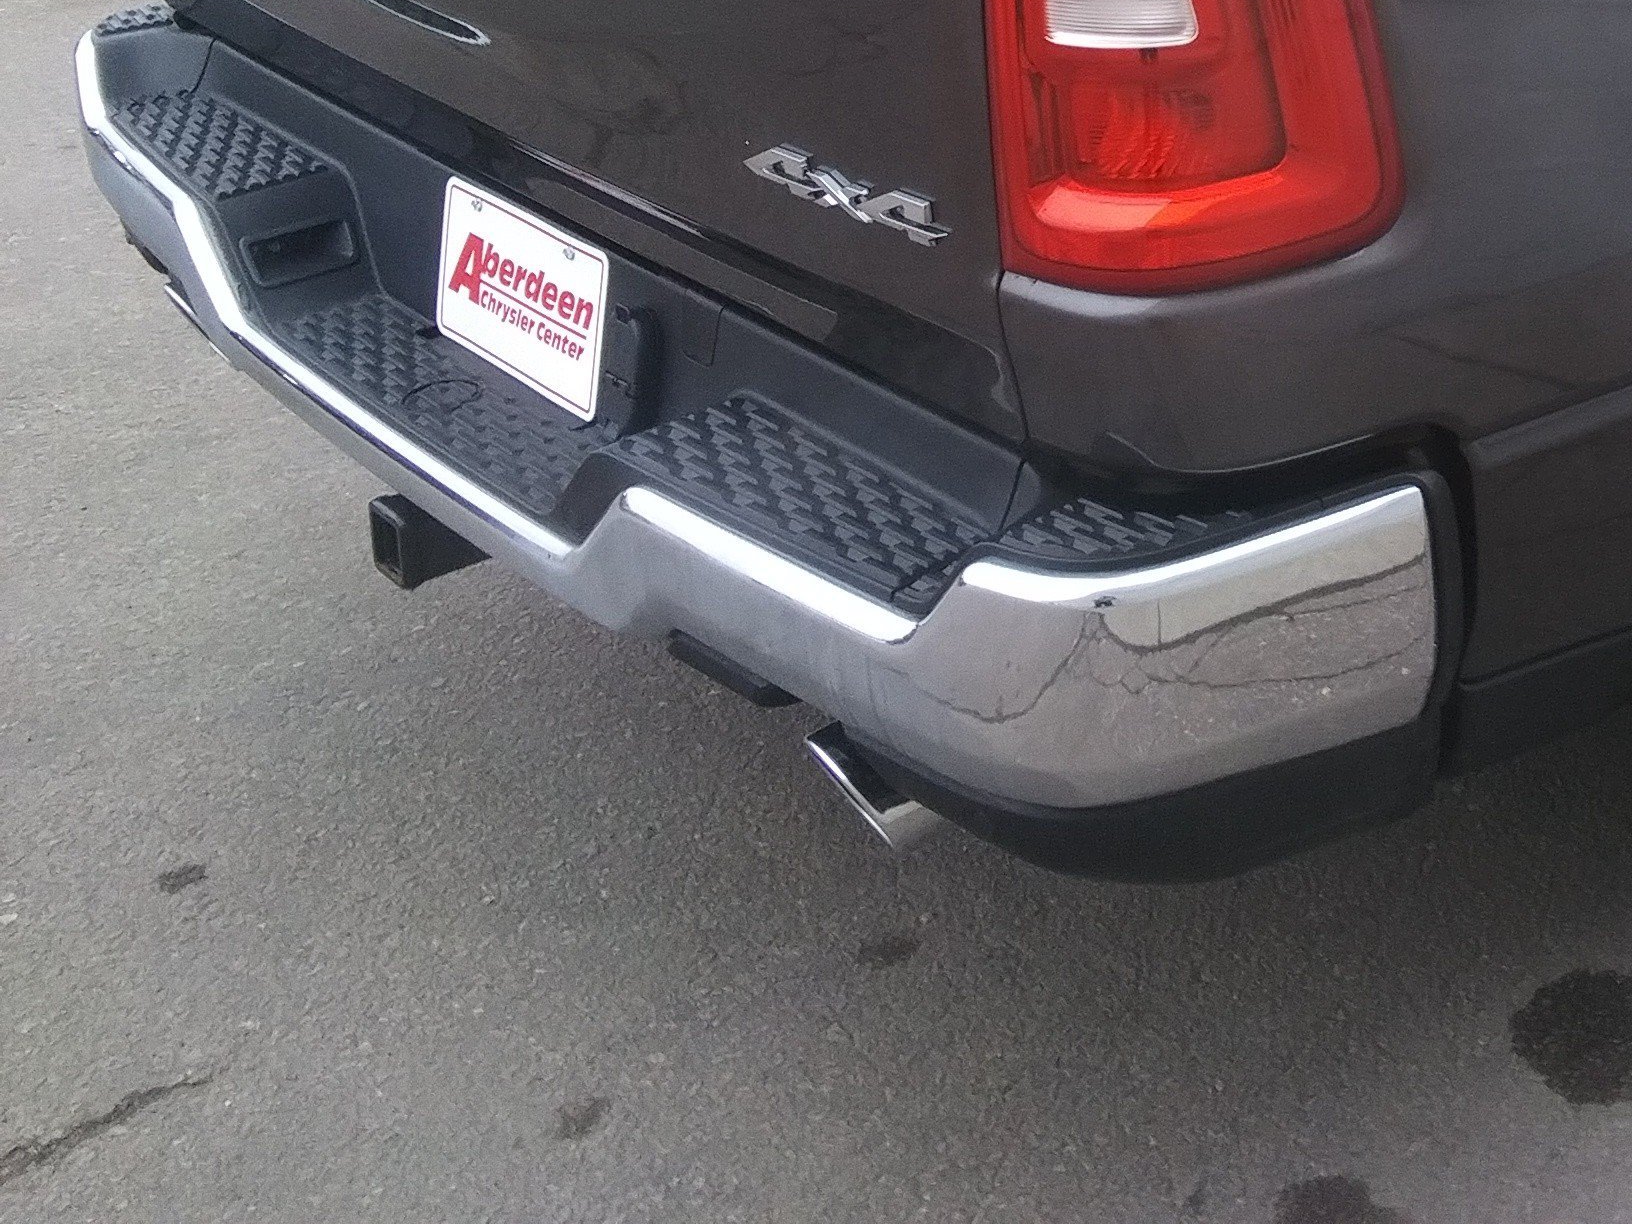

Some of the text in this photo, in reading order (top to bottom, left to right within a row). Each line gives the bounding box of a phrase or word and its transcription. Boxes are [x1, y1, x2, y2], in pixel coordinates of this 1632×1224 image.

[448, 232, 594, 330] Aberdeen
[479, 289, 585, 362] Chrysler Center
